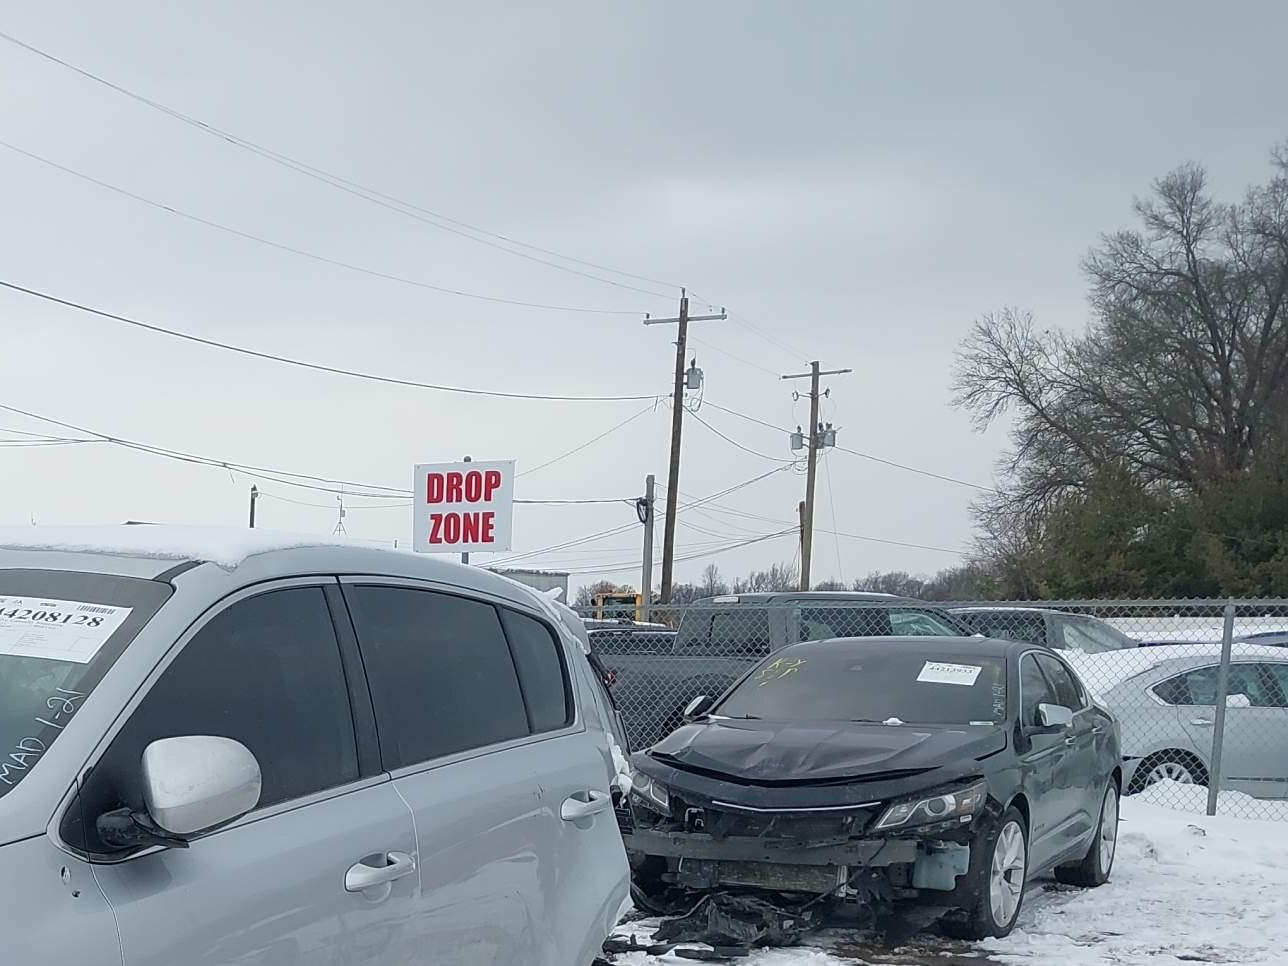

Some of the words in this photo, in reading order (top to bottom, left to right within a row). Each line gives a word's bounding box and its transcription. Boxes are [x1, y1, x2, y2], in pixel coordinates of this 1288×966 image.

[426, 470, 502, 504] DROP
[428, 511, 495, 545] ZONE
[34, 687, 87, 729] 1-21
